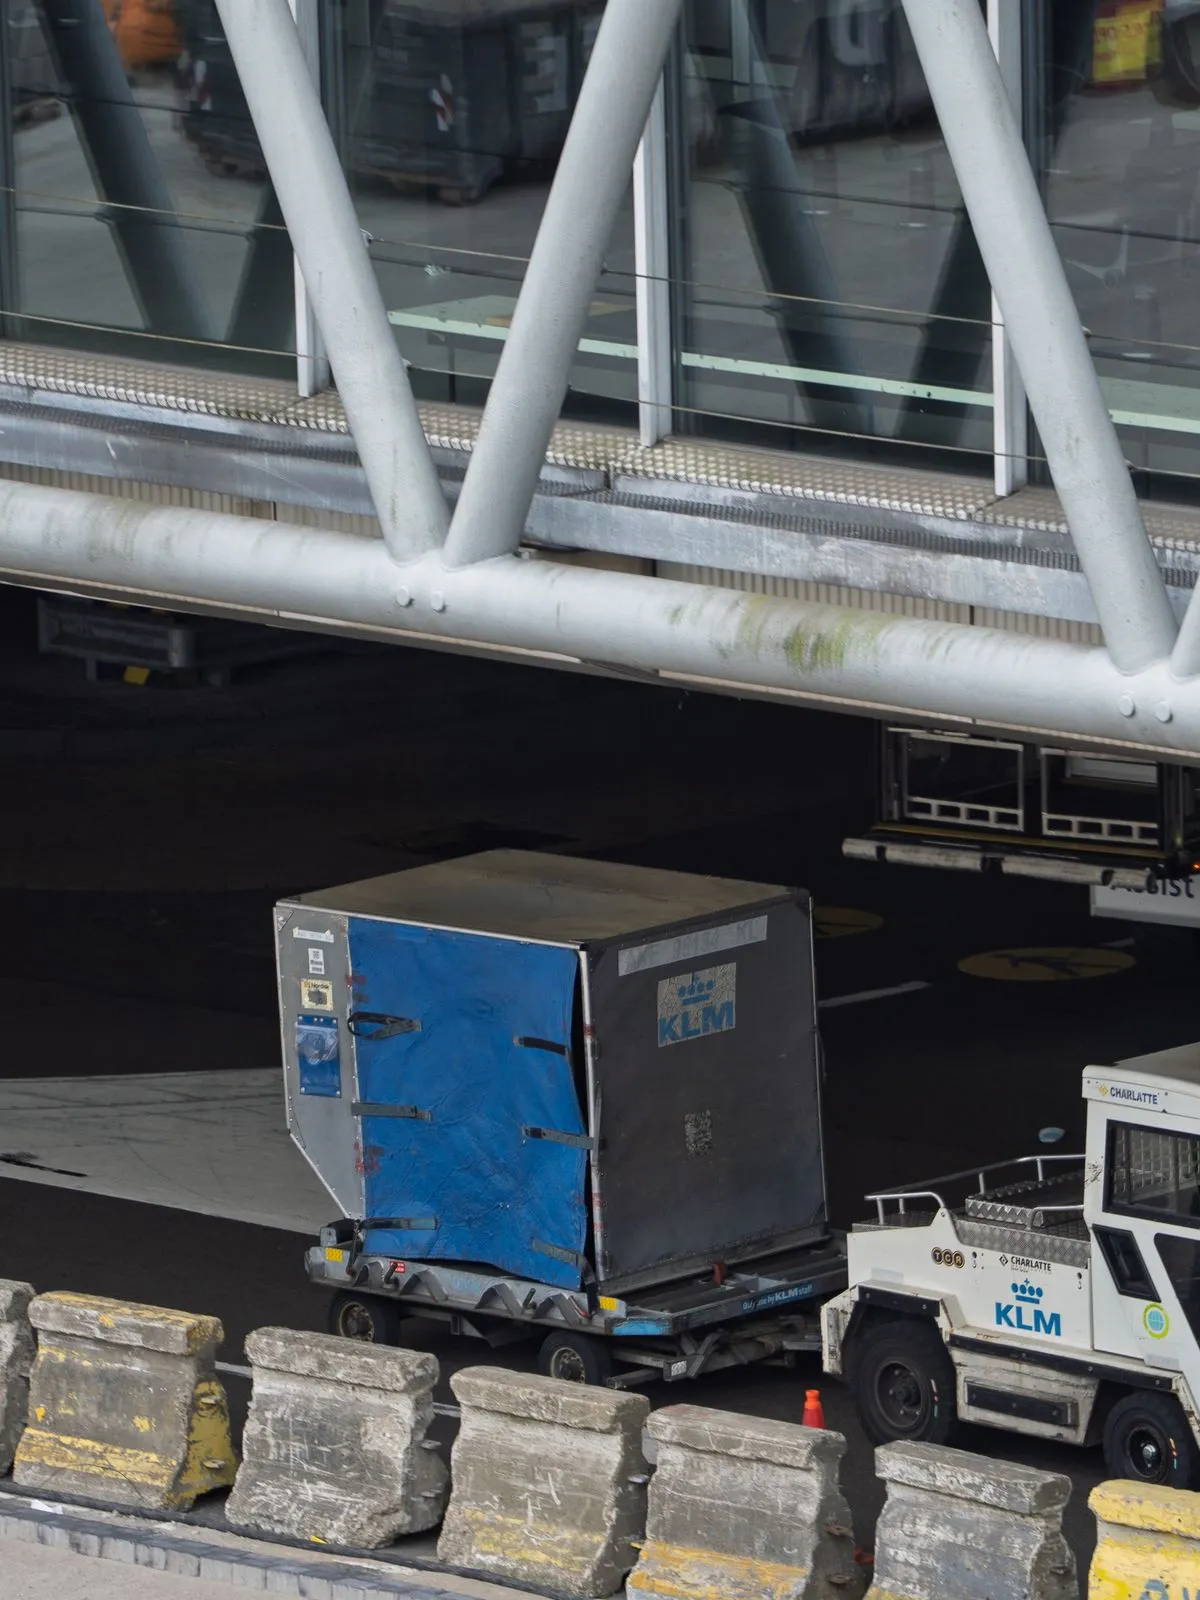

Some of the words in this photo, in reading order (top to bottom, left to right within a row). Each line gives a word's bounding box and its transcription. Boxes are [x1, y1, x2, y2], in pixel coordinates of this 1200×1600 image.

[658, 1000, 735, 1046] KLM
[1109, 1086, 1158, 1105] CHARLATTE
[932, 1247, 965, 1269] TCR
[1010, 1255, 1052, 1272] CHARLATTE
[775, 1287, 798, 1302] KLM
[995, 1302, 1061, 1337] KLM
